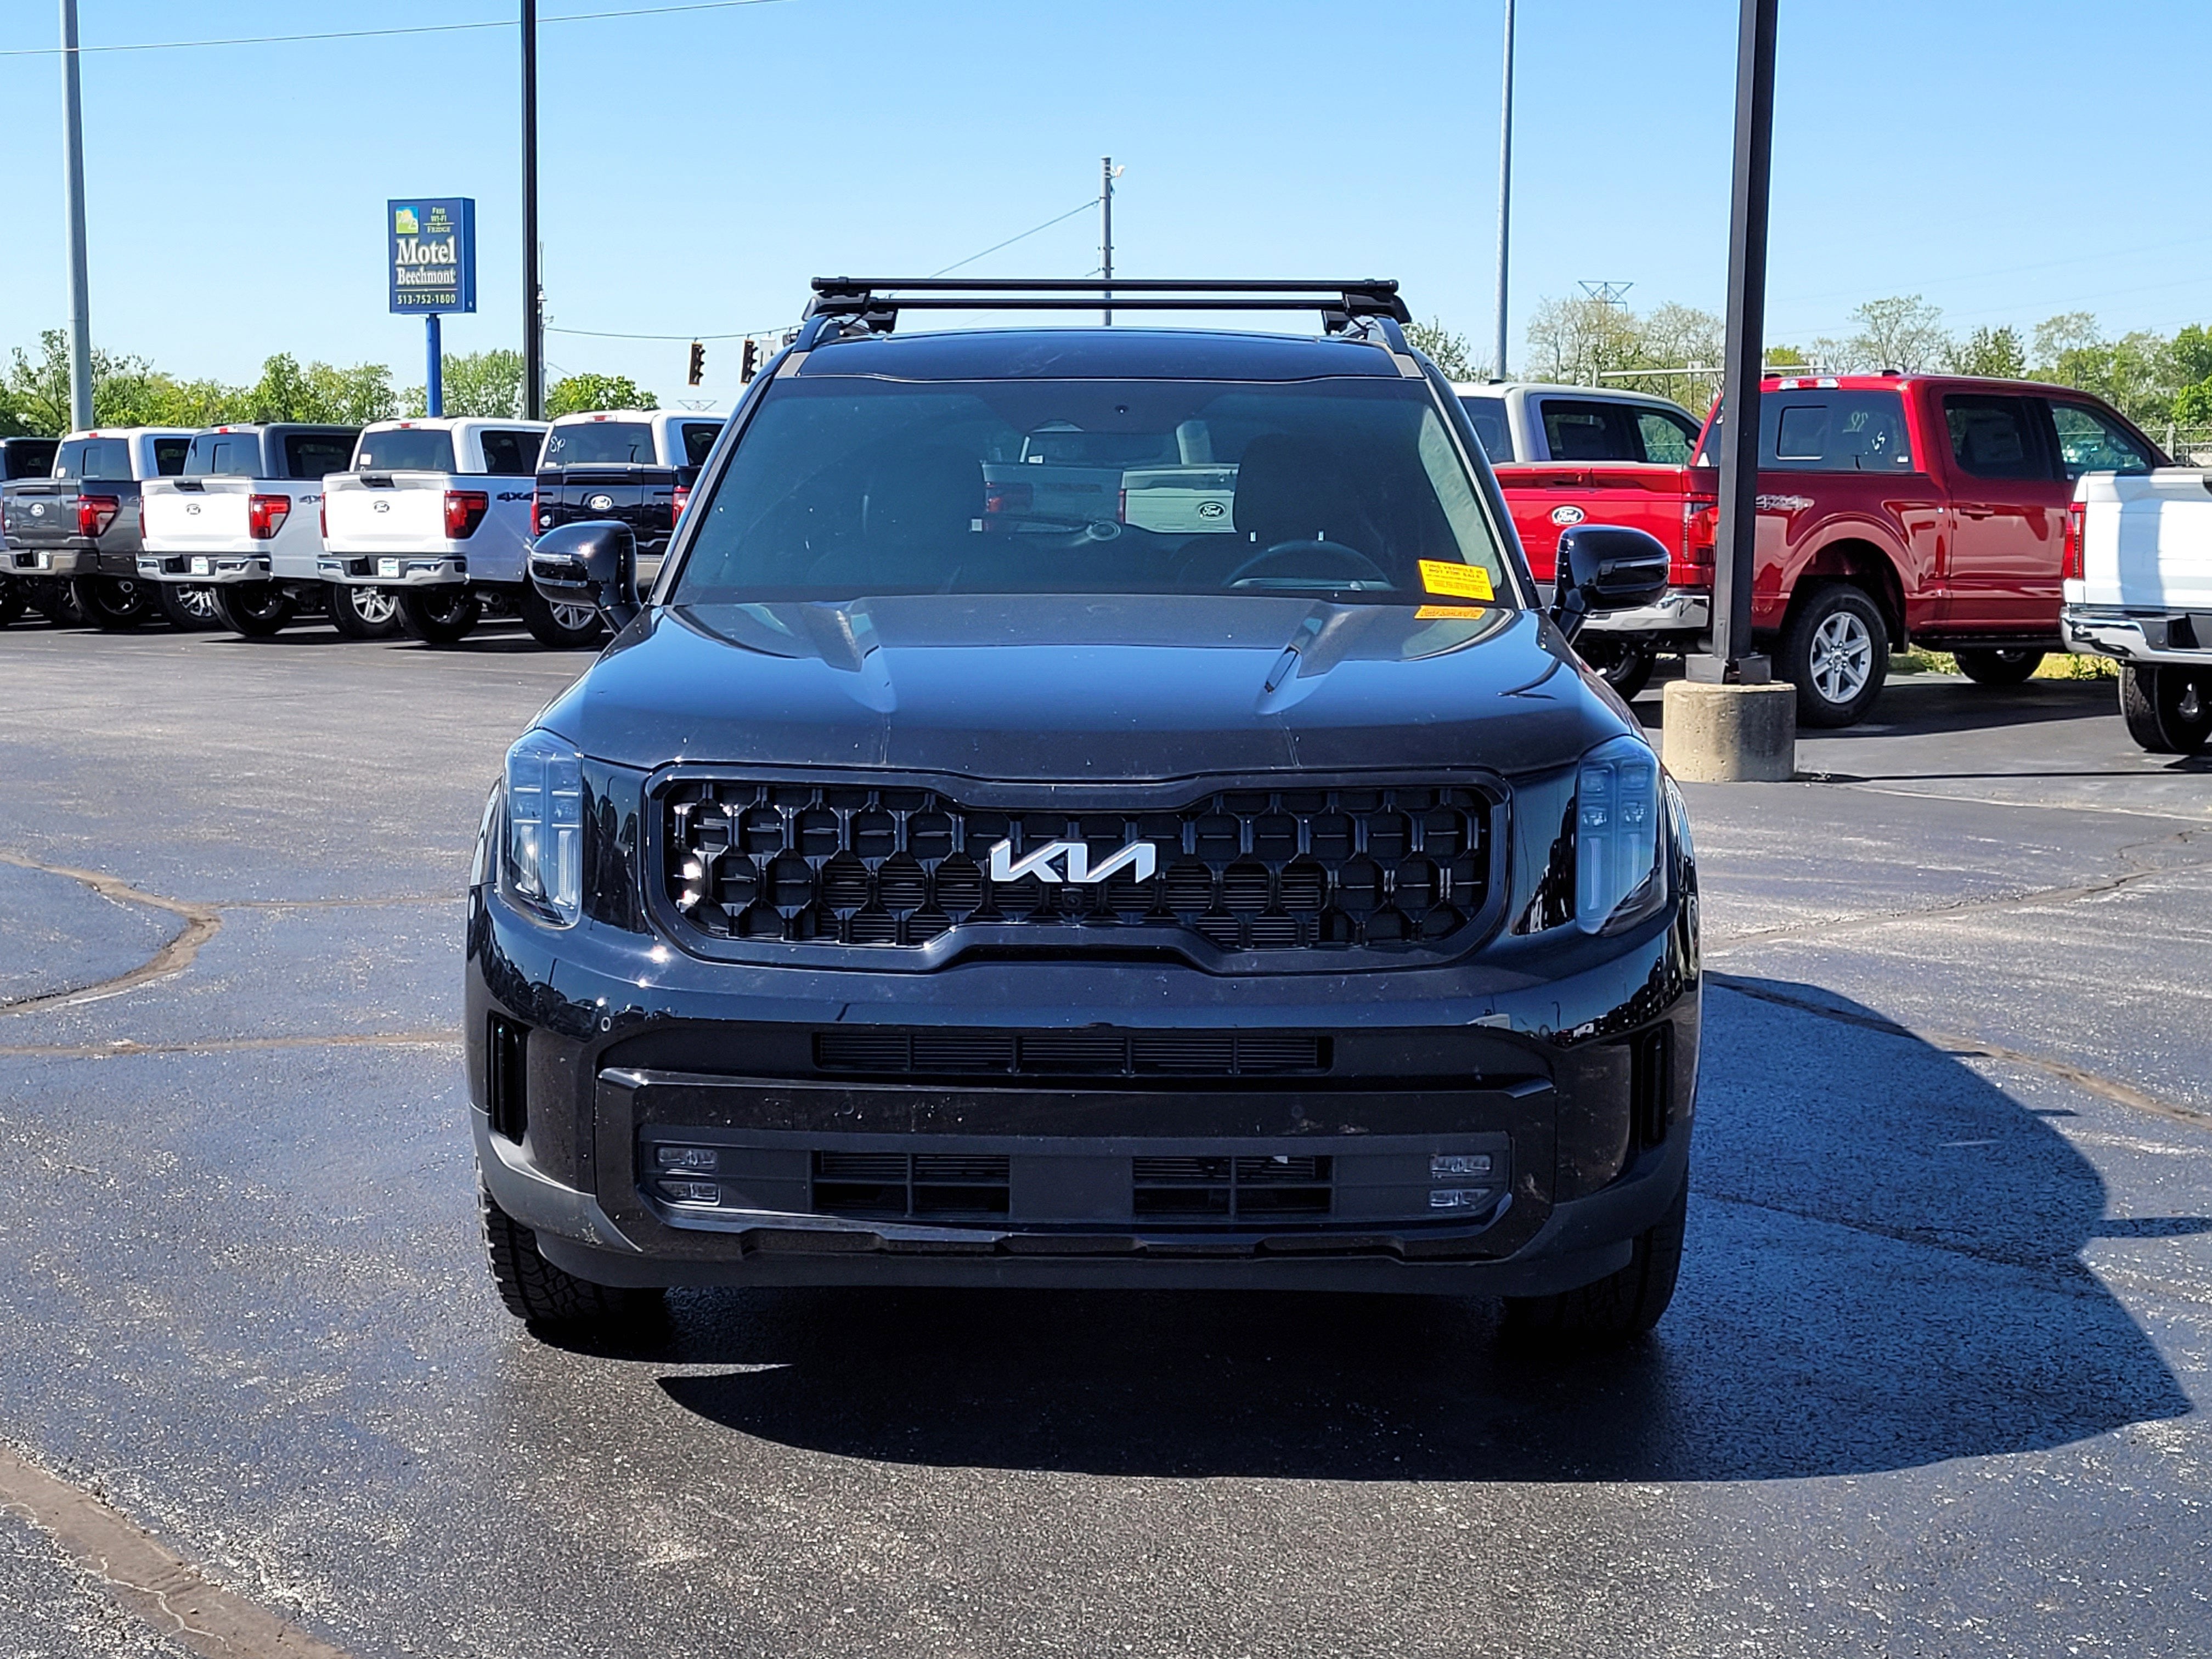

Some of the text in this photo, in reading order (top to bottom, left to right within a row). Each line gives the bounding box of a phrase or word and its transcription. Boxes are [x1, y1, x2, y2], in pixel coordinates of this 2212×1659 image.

[395, 235, 457, 265] Motel
[396, 267, 456, 285] Beechmont
[990, 838, 1156, 883] KIA
